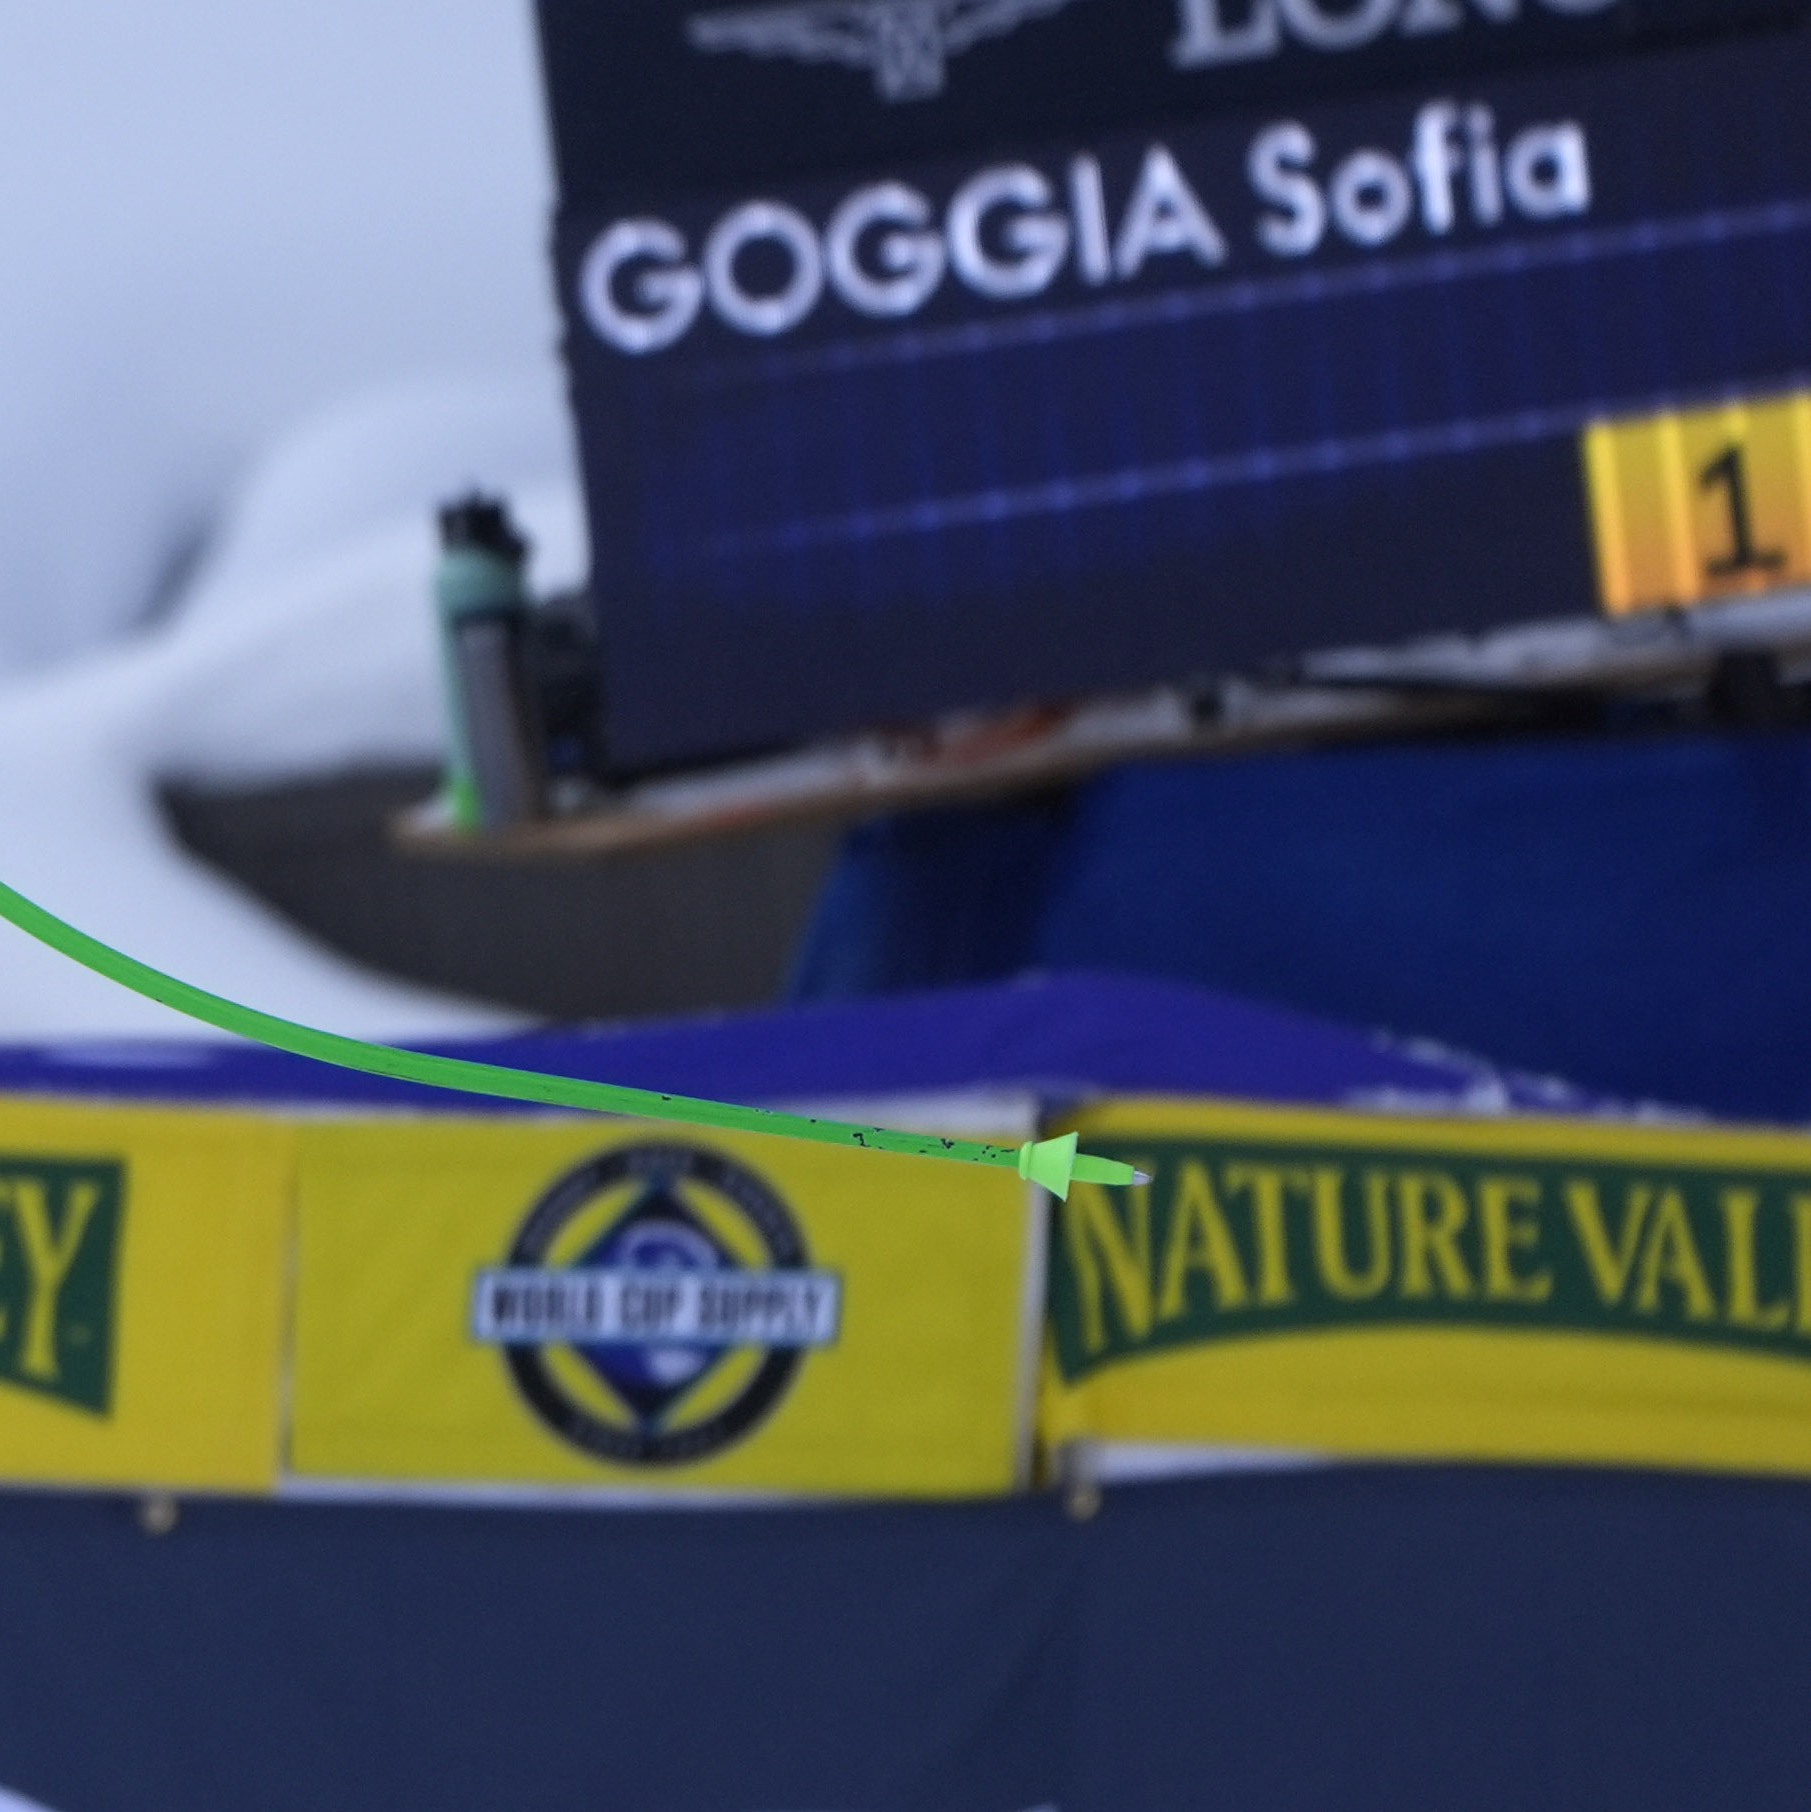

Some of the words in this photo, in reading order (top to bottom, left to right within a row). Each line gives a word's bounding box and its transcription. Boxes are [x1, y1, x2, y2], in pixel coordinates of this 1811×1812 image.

[581, 144, 1227, 354] GOGGIA
[1248, 101, 1592, 257] Sofia
[1698, 441, 1785, 583] 1
[1063, 1160, 1553, 1354] NATURE
